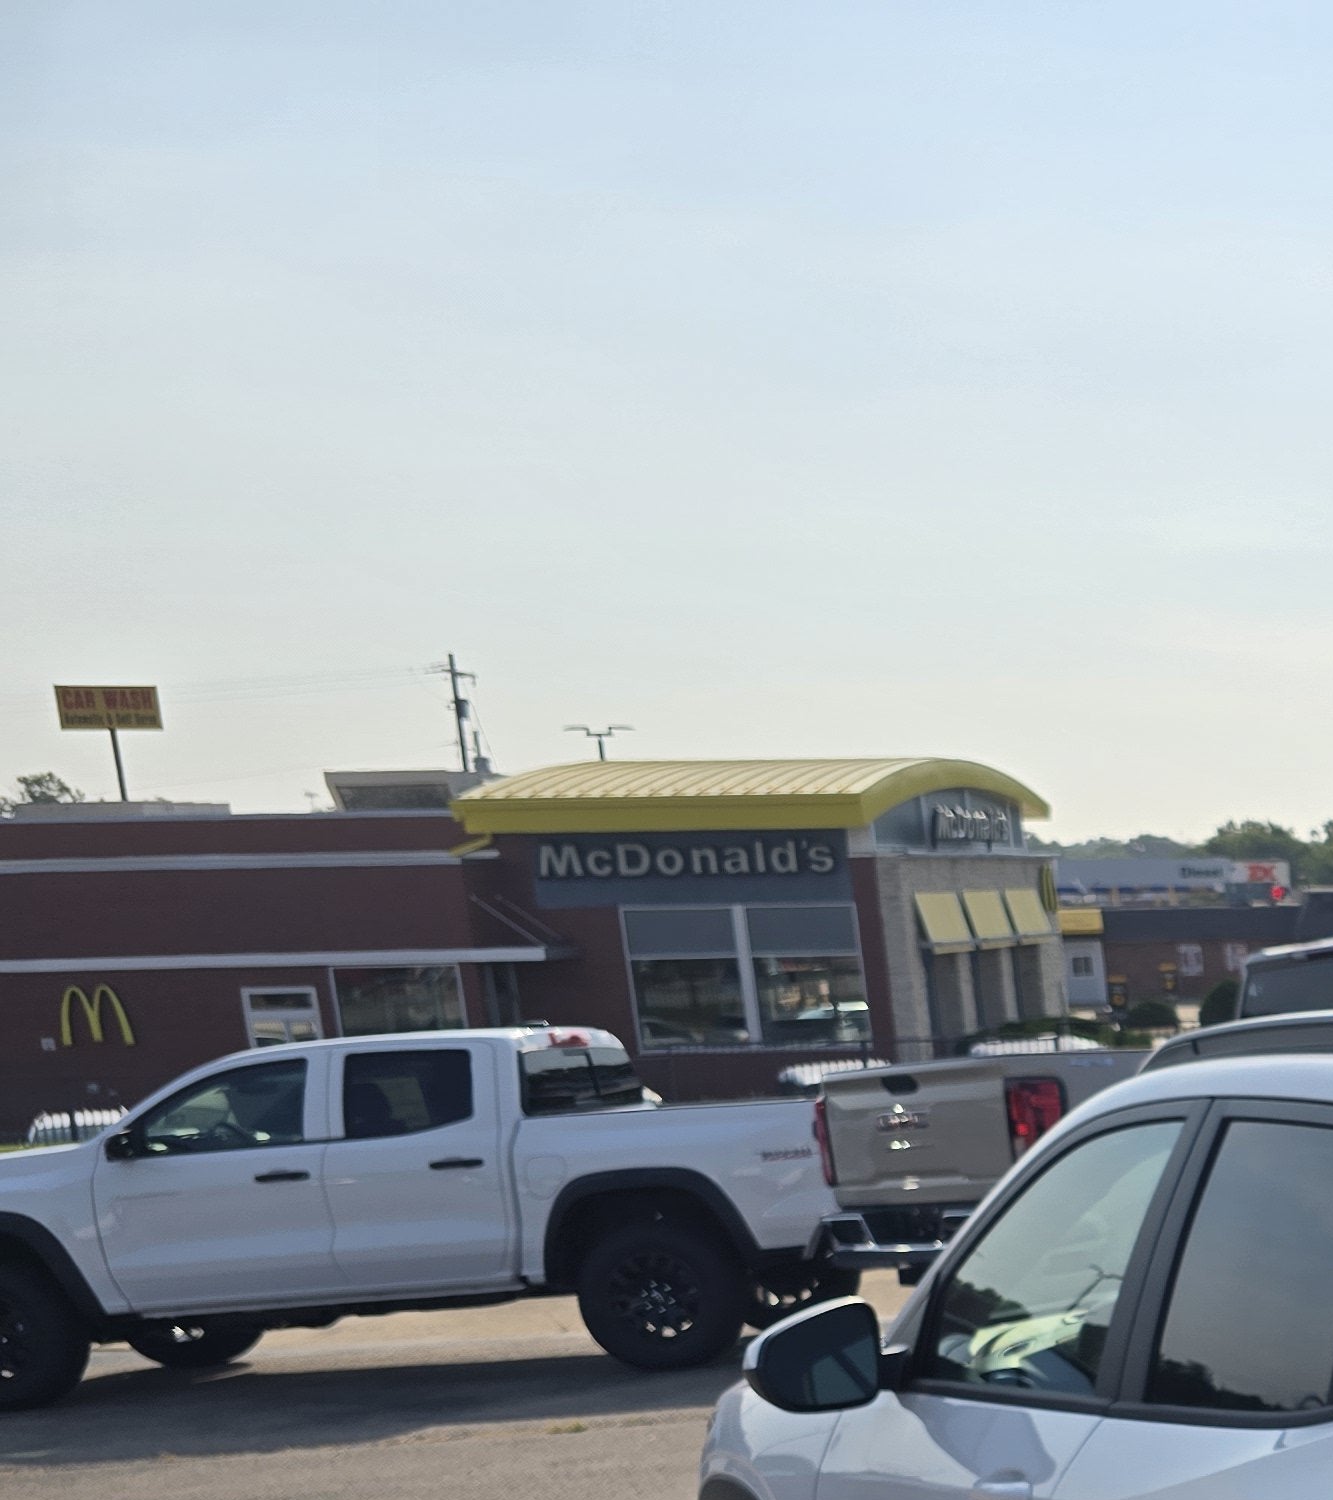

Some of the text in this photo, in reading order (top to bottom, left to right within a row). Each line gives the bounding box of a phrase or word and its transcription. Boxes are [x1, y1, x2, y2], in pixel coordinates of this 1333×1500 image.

[61, 689, 154, 710] CAR WASH
[539, 839, 836, 878] McDonald's
